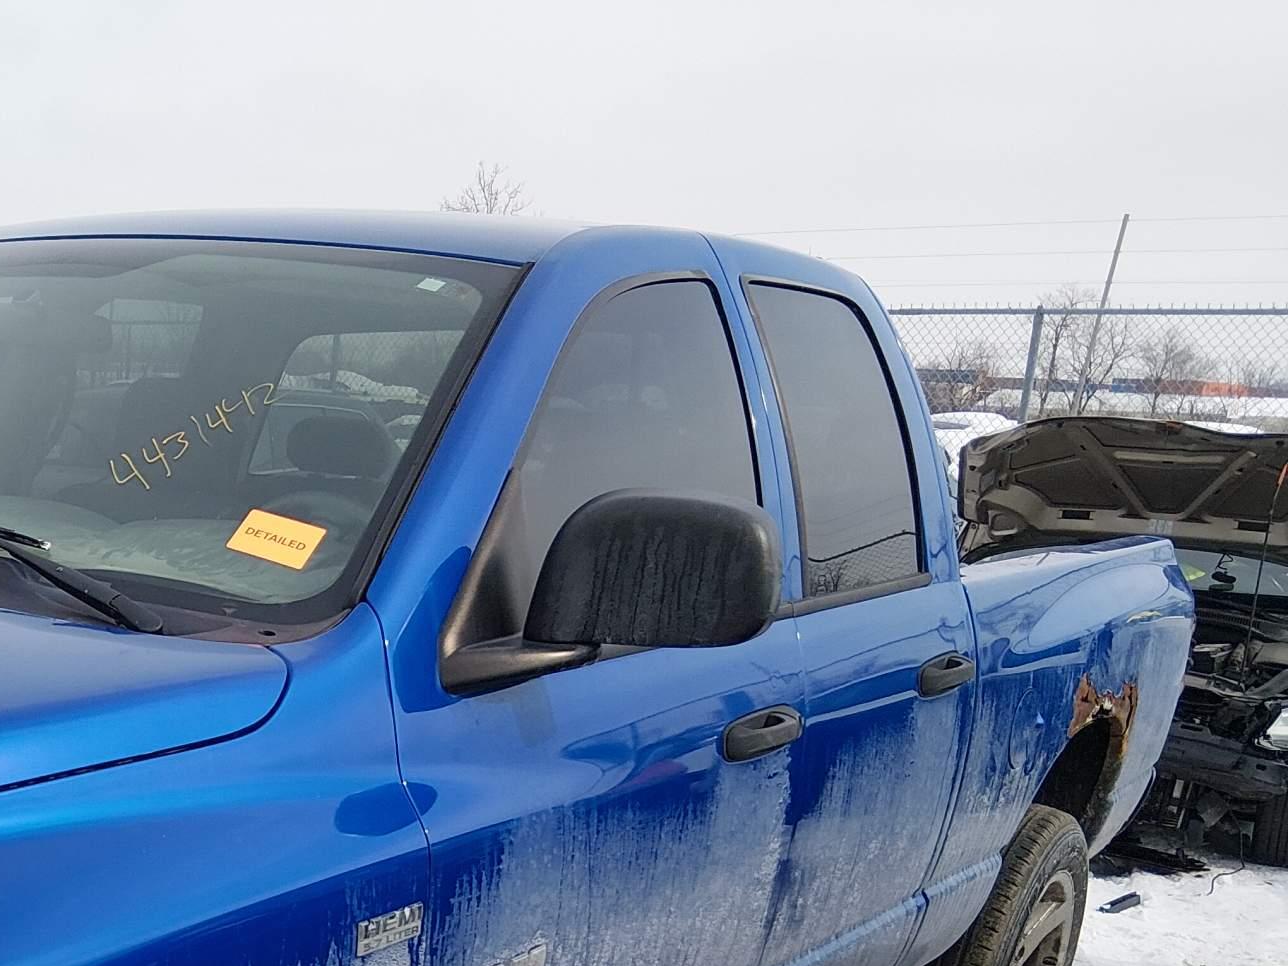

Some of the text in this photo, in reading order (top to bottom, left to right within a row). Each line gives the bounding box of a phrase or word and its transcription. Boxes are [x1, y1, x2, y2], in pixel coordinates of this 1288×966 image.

[244, 526, 306, 552] DETAILED
[362, 904, 422, 939] HEMI
[385, 926, 419, 944] LITER
